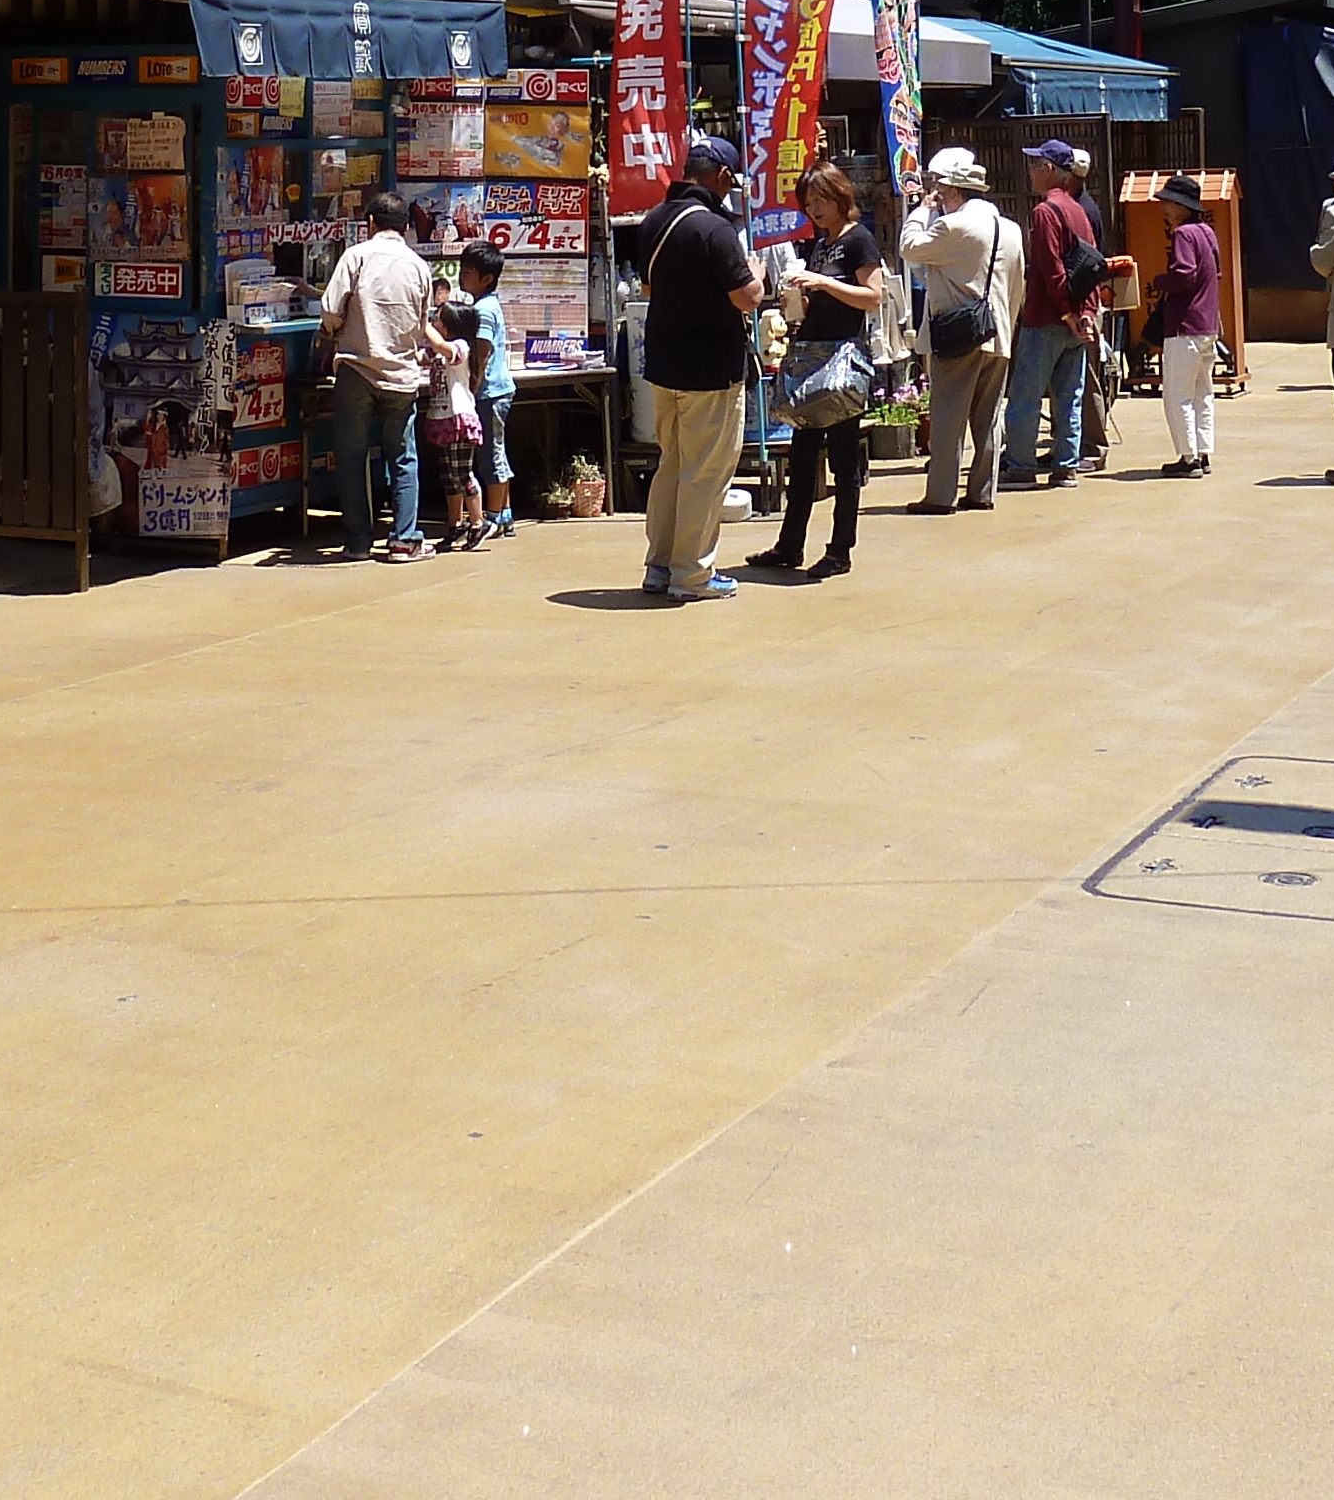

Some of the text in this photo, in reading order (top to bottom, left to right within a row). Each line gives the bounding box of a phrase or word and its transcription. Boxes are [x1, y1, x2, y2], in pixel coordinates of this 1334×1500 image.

[77, 59, 127, 76] NUMBERS
[148, 60, 173, 78] LOTO
[557, 81, 587, 93] 宝くじ
[489, 185, 585, 200] ドリーム ミリオン
[485, 200, 582, 214] ジャンボ ドリーム
[267, 219, 348, 246] ドリームジャンボ
[551, 233, 582, 250] まで
[116, 268, 177, 293] 発売中
[529, 339, 585, 355] NUMBERS
[143, 508, 191, 532] 3億円
